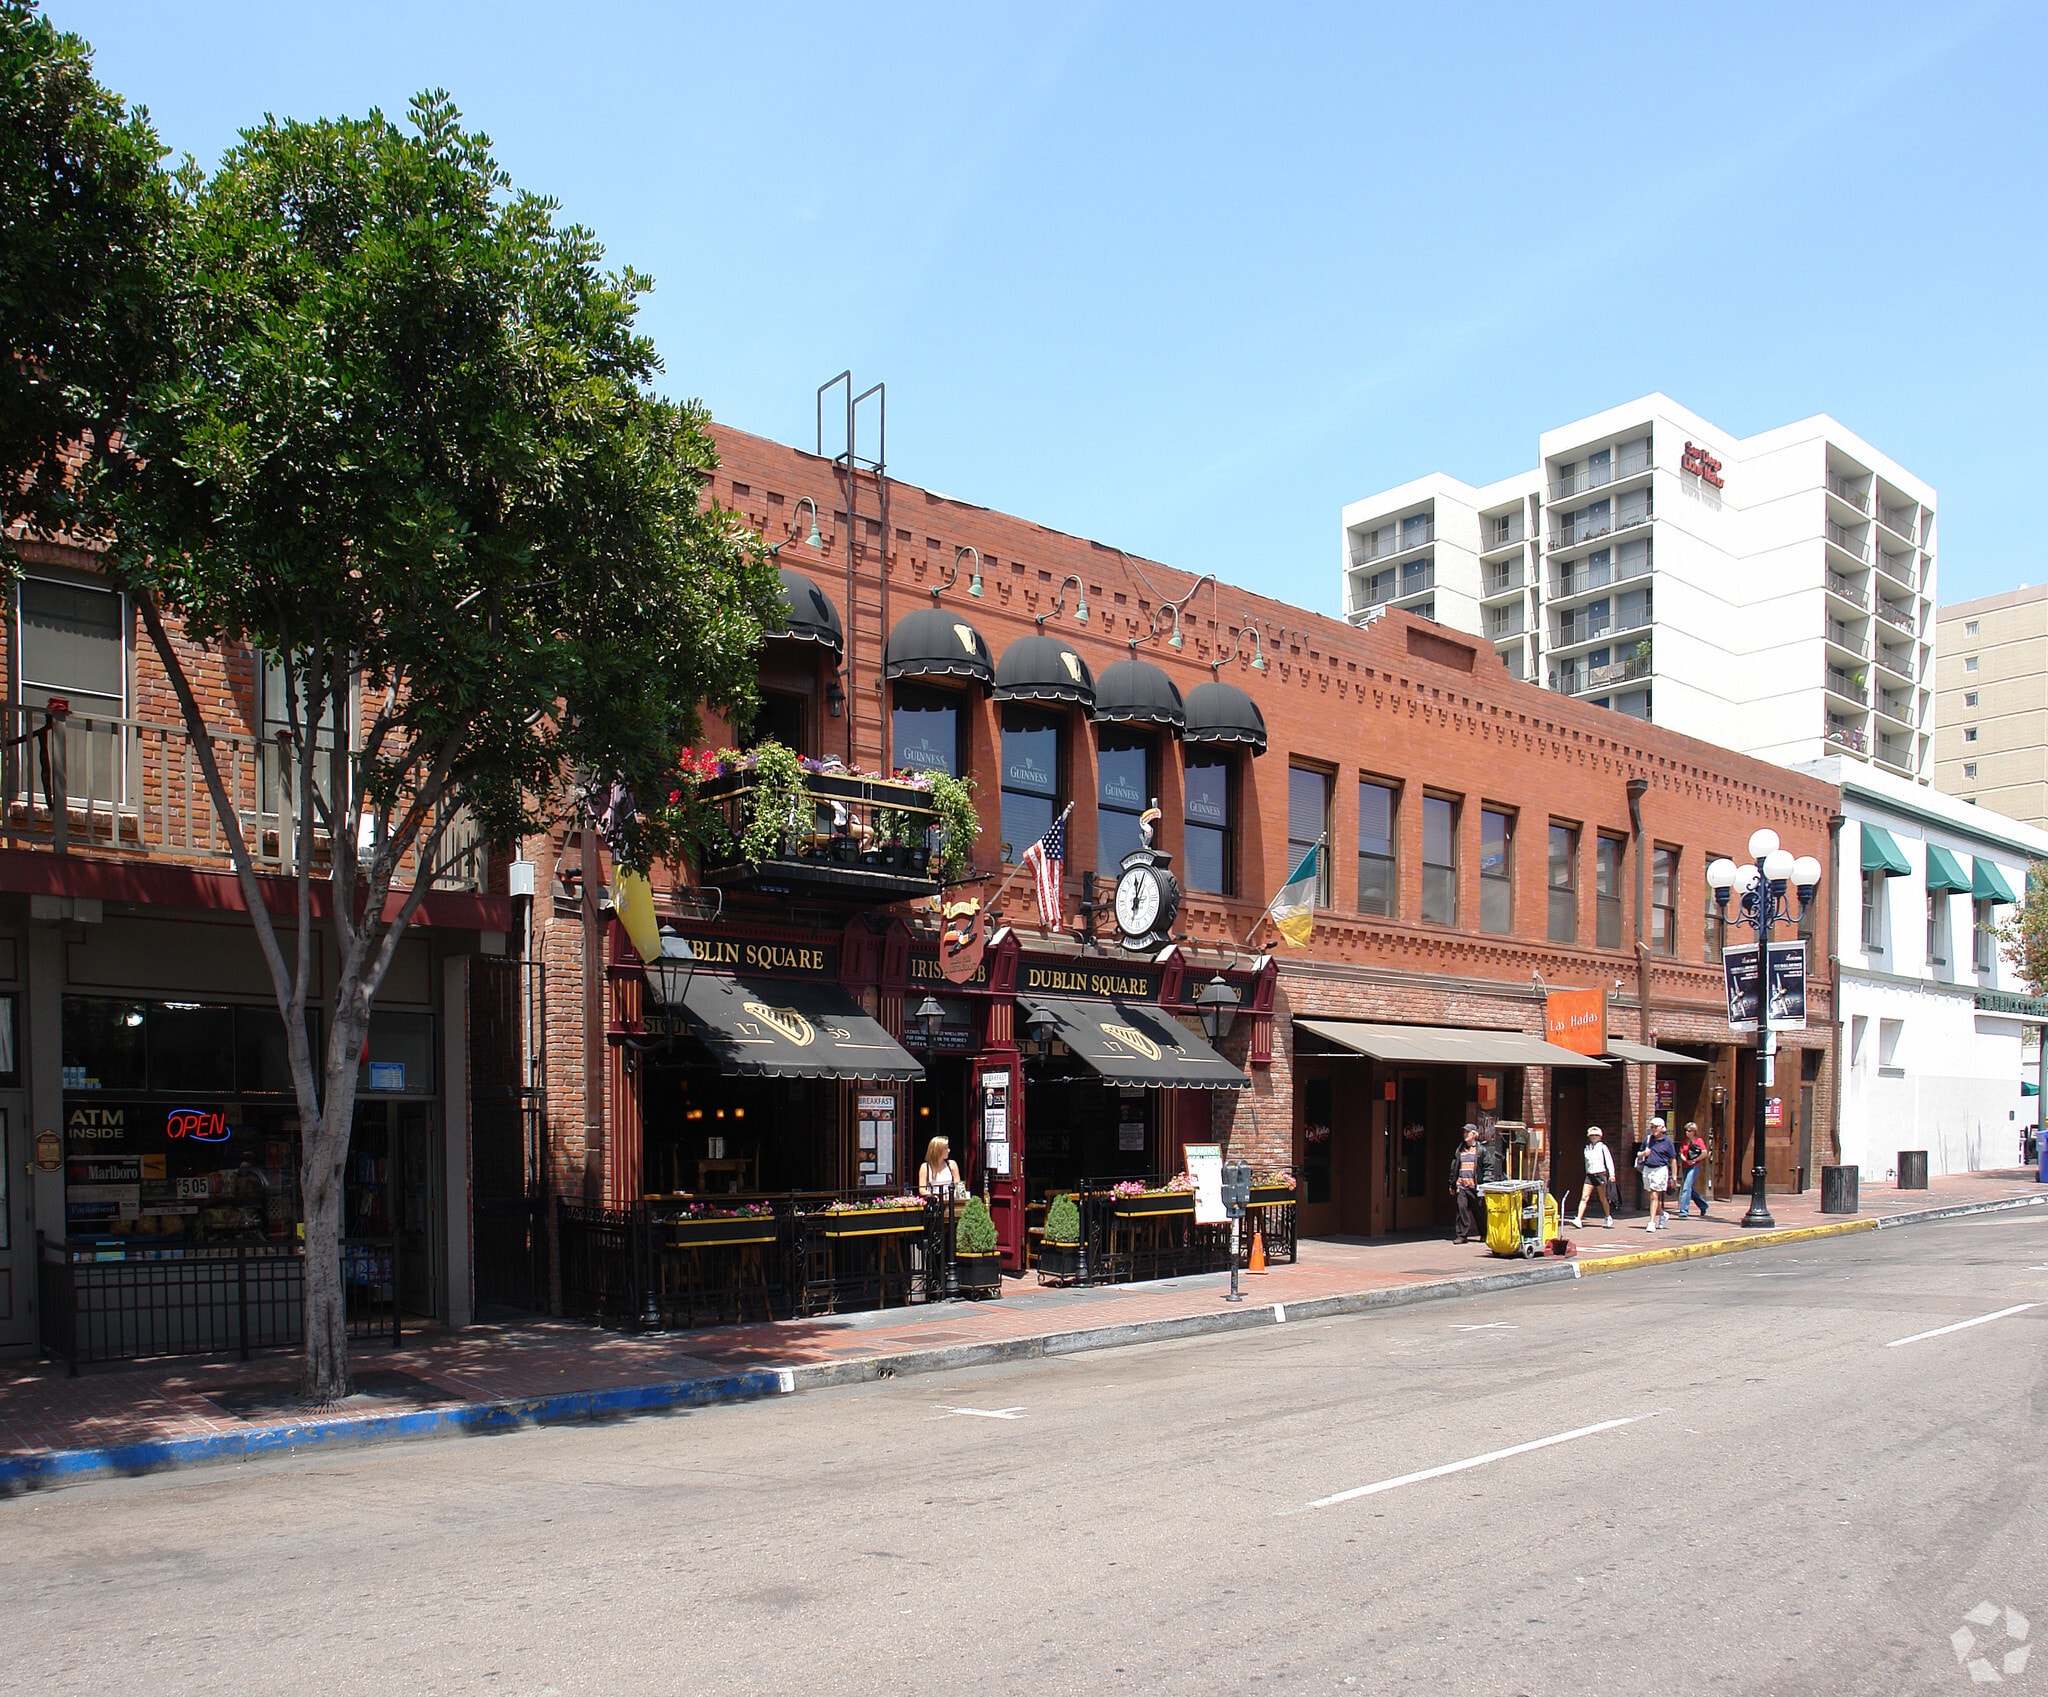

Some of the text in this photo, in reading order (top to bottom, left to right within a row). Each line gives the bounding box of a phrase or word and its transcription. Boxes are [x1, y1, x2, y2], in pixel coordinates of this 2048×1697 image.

[903, 747, 946, 765] GUINNESS
[1010, 765, 1048, 784] GUINNESS
[1105, 784, 1139, 801] GUINNESS
[1189, 800, 1221, 817] GUINNESS
[746, 944, 824, 970] SQUARE
[911, 958, 946, 979] IRIS
[1028, 968, 1148, 996] DUBLIN SQUARE
[1550, 1011, 1598, 1032] Las Hadas
[733, 1021, 851, 1040] 17 59
[1102, 1041, 1123, 1052] 17
[858, 1097, 892, 1105] BREAKFAST
[68, 1109, 125, 1126] ATM
[166, 1113, 226, 1138] OPEN
[68, 1128, 125, 1139] INSIDE
[88, 1165, 138, 1180] Marlboro
[71, 1205, 118, 1214] Parliament
